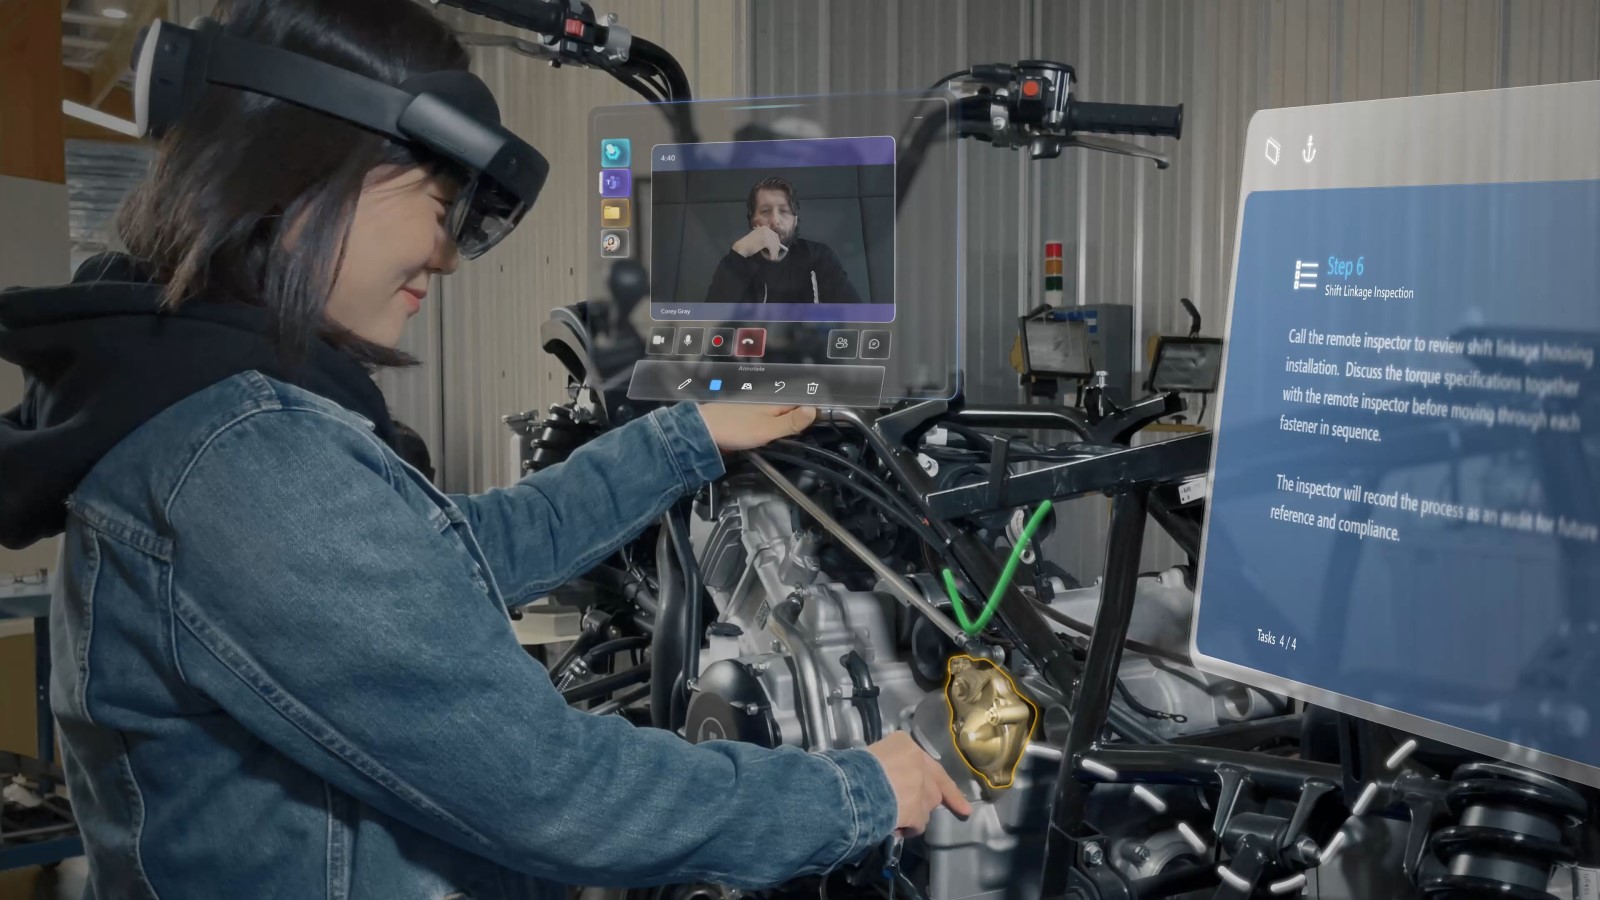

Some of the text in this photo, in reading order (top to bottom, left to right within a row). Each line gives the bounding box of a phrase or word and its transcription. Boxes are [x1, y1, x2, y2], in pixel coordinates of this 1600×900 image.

[660, 154, 676, 162] 4:40
[1327, 256, 1364, 280] Step 6
[1325, 284, 1414, 301] Shift Linkage Inspection
[677, 308, 690, 316] Gray
[1288, 328, 1594, 370] Call the remote inspector to review shift linkage housing
[1285, 356, 1580, 400] installation. Discuss the torque specifications together
[1282, 386, 1581, 434] with the remote inspector before moving through each
[1279, 414, 1382, 443] fastener in sequence.
[1276, 473, 1294, 492] The
[1295, 476, 1342, 499] inspector
[1343, 484, 1362, 503] will
[1363, 491, 1398, 509] record
[1400, 492, 1419, 511] the
[1420, 499, 1464, 518] process
[1466, 506, 1479, 522] as
[1481, 508, 1498, 525] an
[1501, 509, 1533, 532] audit
[1557, 514, 1599, 542] future
[1270, 504, 1401, 542] reference and compliance.
[1257, 628, 1276, 645] Tasks
